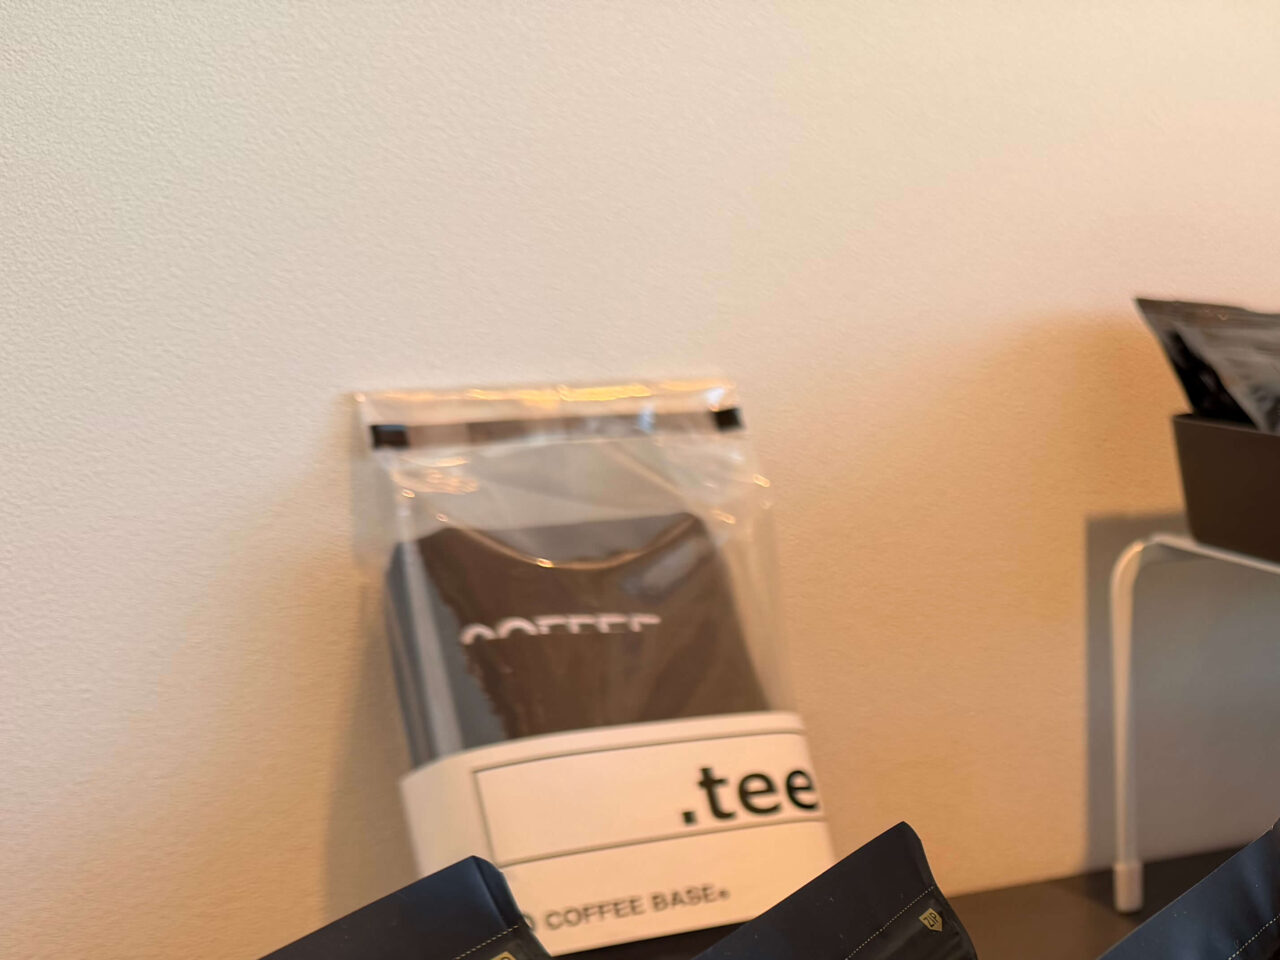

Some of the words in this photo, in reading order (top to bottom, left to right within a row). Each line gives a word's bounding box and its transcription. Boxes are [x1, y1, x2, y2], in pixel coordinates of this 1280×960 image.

[681, 766, 820, 826] .tee
[545, 896, 646, 931] COFFEE
[923, 912, 939, 928] ZIP
